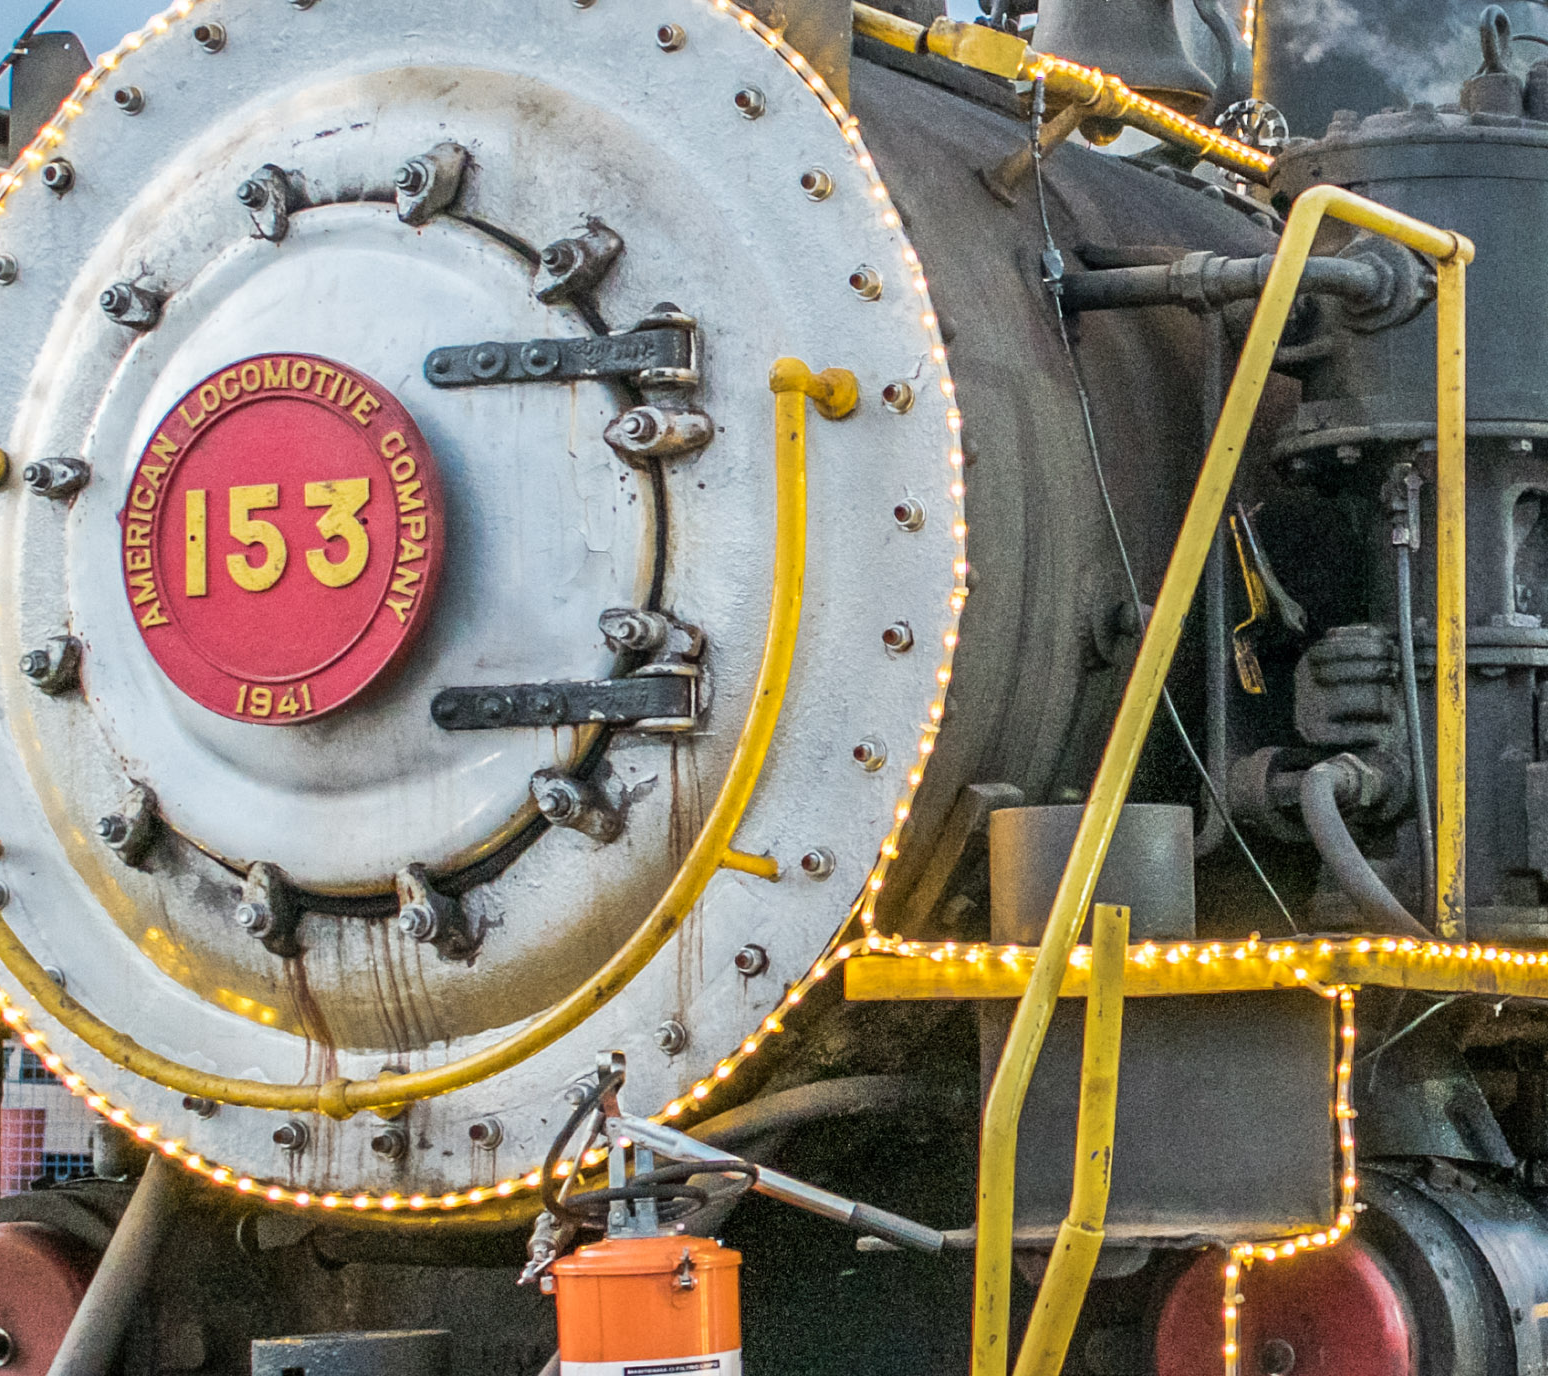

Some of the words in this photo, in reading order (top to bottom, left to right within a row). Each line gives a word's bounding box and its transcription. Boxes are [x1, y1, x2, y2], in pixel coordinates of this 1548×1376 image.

[125, 434, 180, 629] AMERICAN
[179, 359, 381, 428] LOCOMOTIVE
[380, 430, 427, 623] COMPANY
[185, 477, 371, 597] 153
[235, 682, 313, 717] 1941
